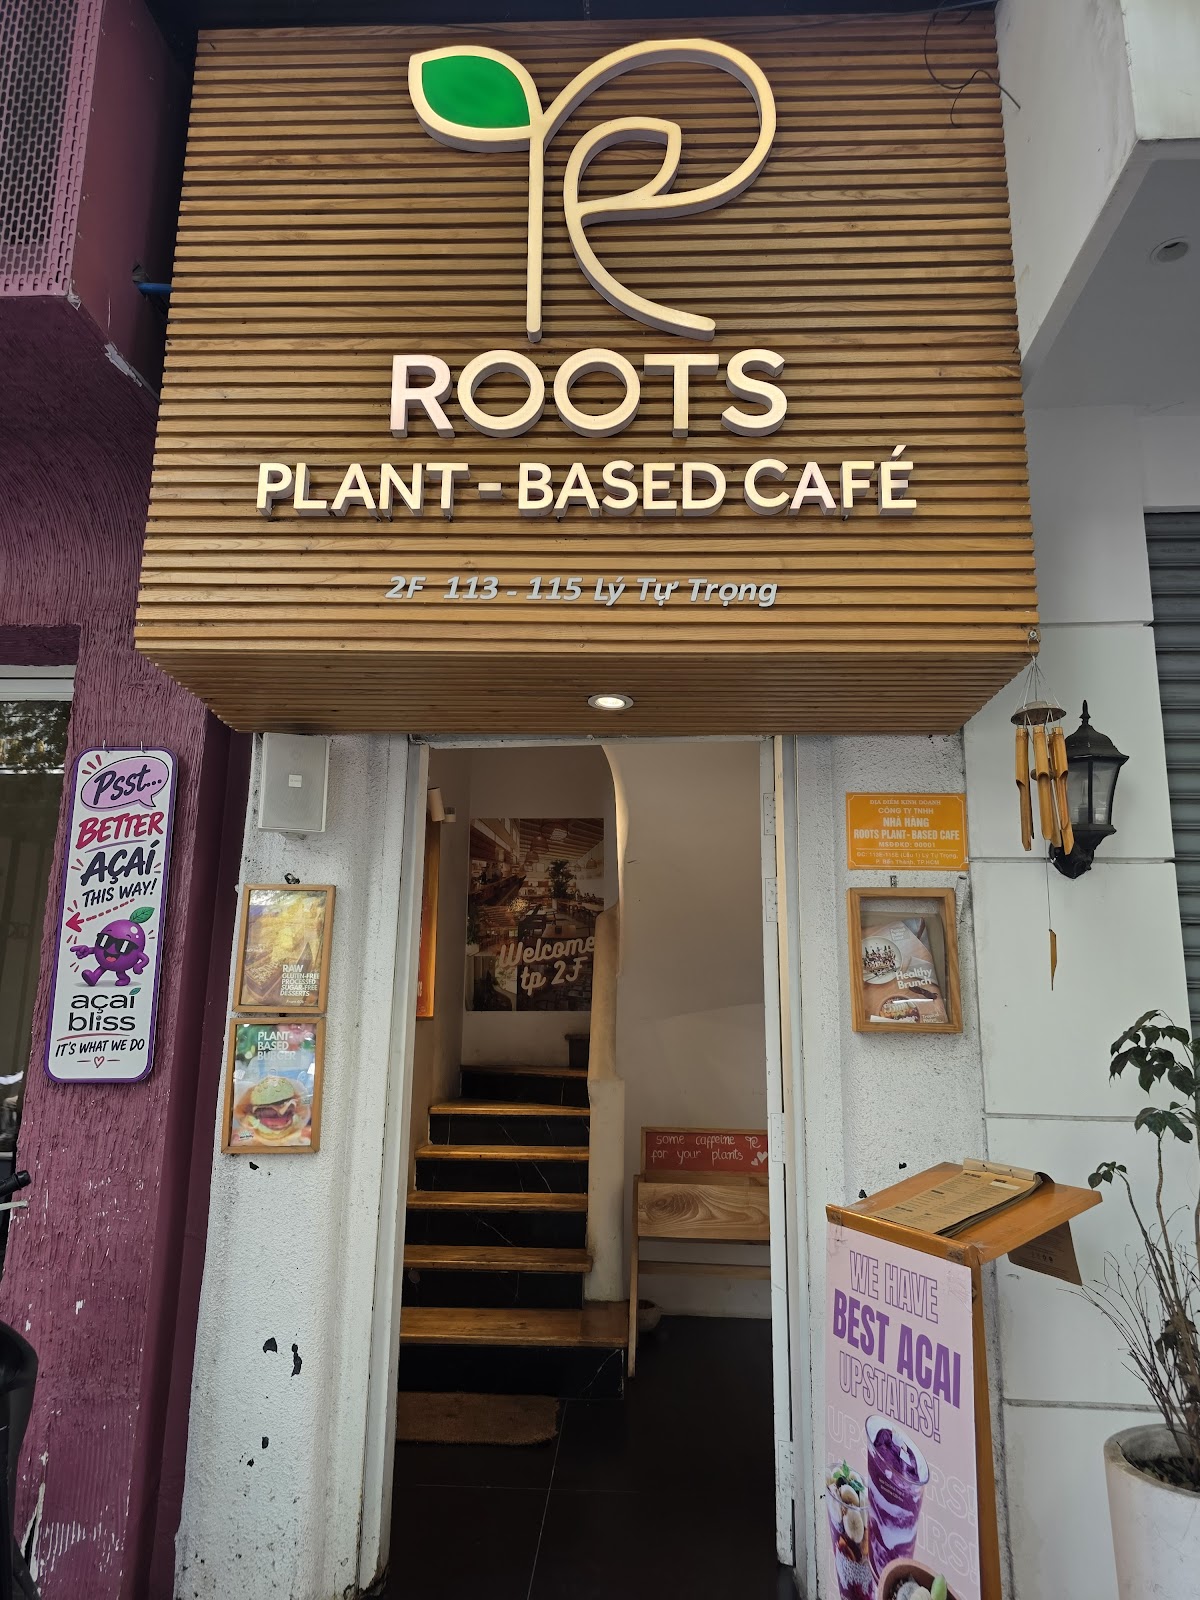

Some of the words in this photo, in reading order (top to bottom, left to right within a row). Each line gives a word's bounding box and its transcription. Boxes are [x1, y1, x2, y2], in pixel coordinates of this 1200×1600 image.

[390, 348, 788, 437] ROOTS
[257, 460, 470, 517] PLANT
[518, 460, 727, 517] BASED
[744, 445, 917, 517] CAFÉ
[385, 575, 426, 600] 2F
[443, 575, 500, 601] 113
[526, 576, 583, 602] 115
[593, 576, 626, 607] Lý
[636, 576, 679, 608] Tự
[687, 577, 779, 609] Trọng
[93, 764, 163, 806] Psst...
[878, 806, 902, 814] CÔNG
[903, 807, 912, 815] TY
[914, 807, 934, 815] TNHH
[75, 811, 165, 850] BETTER
[883, 815, 902, 828] NHÀ
[904, 815, 929, 827] HÀNG
[853, 829, 880, 840] ROOTS
[940, 830, 960, 841] CAFE
[80, 839, 160, 887] AÇAÍ
[82, 885, 115, 908] THIS
[119, 877, 158, 901] WAY!
[499, 936, 596, 969] Welcome
[281, 972, 320, 980] GLUTEN-FREE
[282, 964, 304, 973] RAW
[550, 956, 588, 986] 2F
[895, 966, 932, 981] Healthy
[897, 976, 932, 990] Brunch
[68, 1011, 136, 1031] bliss
[257, 1031, 294, 1041] PLANT-
[257, 1040, 290, 1051] BASED
[55, 1041, 77, 1058] IT'S
[79, 1039, 109, 1054] WHAT
[111, 1039, 128, 1052] WE
[129, 1038, 145, 1052] DO
[257, 1050, 296, 1061] BURGER
[656, 1134, 686, 1145] some
[695, 1134, 736, 1149] caffeine
[651, 1149, 668, 1164] for
[677, 1149, 702, 1165] your
[711, 1148, 744, 1167] plants
[850, 1251, 879, 1300] WE
[884, 1262, 939, 1325] HAVE
[833, 1288, 890, 1365] BEST
[896, 1323, 961, 1410] ACAI
[839, 1350, 941, 1444] UPSTAIRS!
